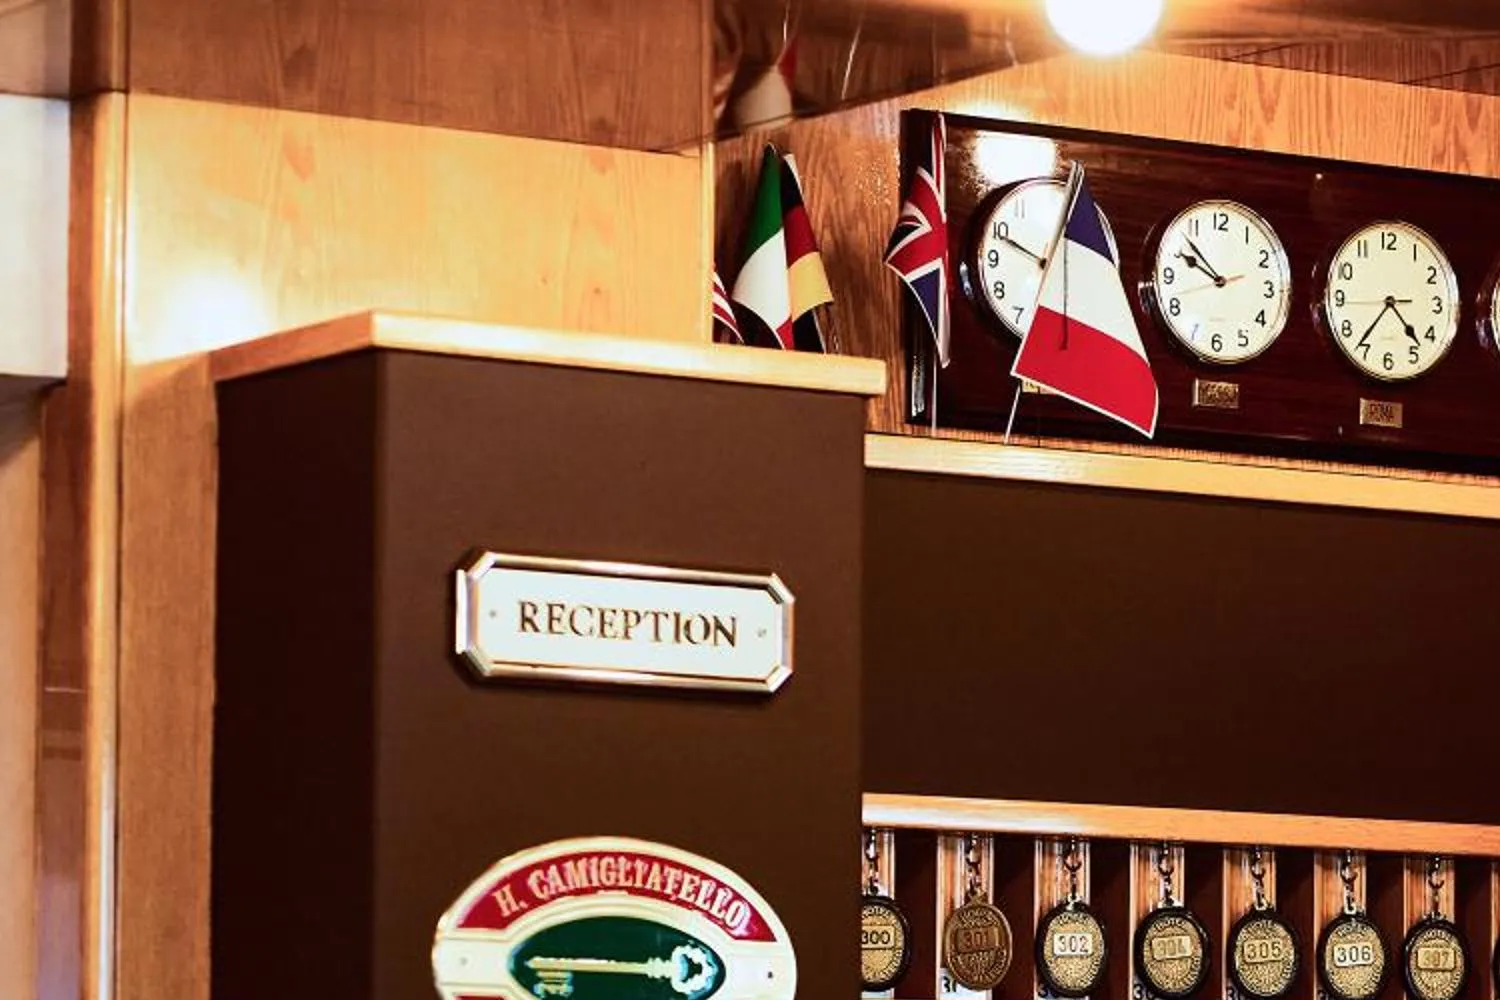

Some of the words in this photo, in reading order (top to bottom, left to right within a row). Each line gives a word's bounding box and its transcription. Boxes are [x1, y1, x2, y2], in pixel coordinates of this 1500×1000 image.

[1015, 199, 1025, 218] 11
[993, 222, 1008, 239] 10
[1189, 219, 1198, 236] 11
[1213, 213, 1229, 231] 12
[1358, 240, 1368, 258] 11
[1381, 232, 1396, 250] 12
[988, 250, 999, 267] 9
[1259, 250, 1269, 268] 2
[1164, 267, 1174, 284] 9
[1338, 263, 1352, 280] 10
[1427, 266, 1436, 284] 2
[994, 281, 1004, 299] 8
[1264, 281, 1274, 298] 3
[1336, 290, 1344, 307] 9
[1170, 298, 1180, 315] 8
[1432, 296, 1442, 314] 3
[1012, 305, 1024, 324] 7
[1255, 310, 1266, 326] 4
[1342, 320, 1352, 337] 8
[1425, 326, 1435, 342] 4
[1211, 334, 1222, 352] 6
[1238, 330, 1248, 346] 5
[1359, 344, 1370, 360] 7
[1384, 352, 1393, 370] 6
[1409, 346, 1418, 364] 5
[517, 601, 738, 648] RECEPTION
[494, 883, 527, 917] H.
[528, 856, 751, 936] CAMIGLIATELLO
[861, 931, 891, 945] 300
[964, 932, 989, 948] 301
[1057, 935, 1089, 953] 302
[1247, 941, 1281, 959] 305
[1338, 945, 1371, 963] 306
